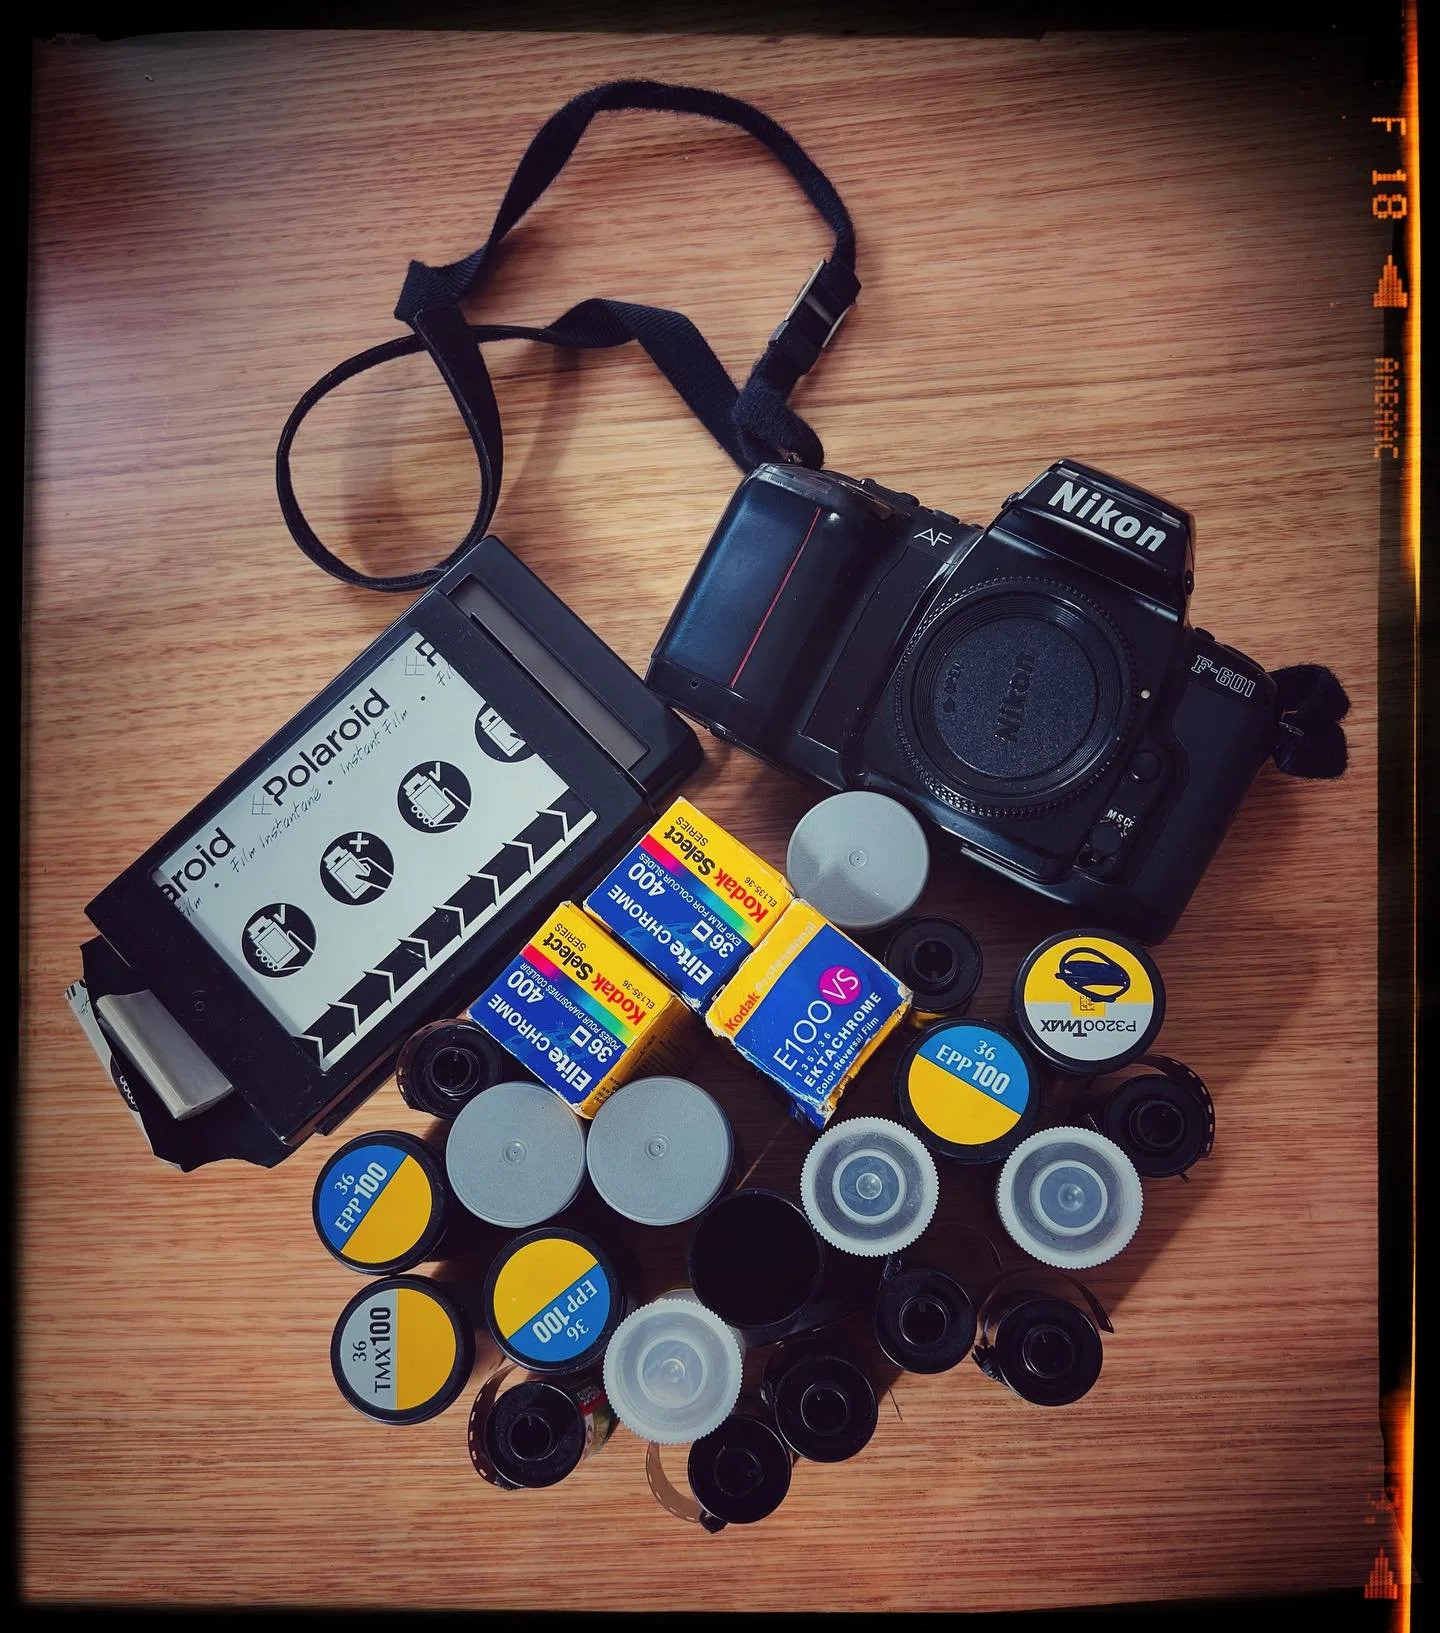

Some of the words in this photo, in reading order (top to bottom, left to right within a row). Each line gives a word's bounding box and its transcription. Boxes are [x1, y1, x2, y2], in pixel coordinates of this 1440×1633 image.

[1048, 480, 1167, 553] Nikon
[913, 527, 953, 547] AF
[1190, 654, 1256, 698] F-601
[262, 687, 391, 808] Polaroid
[230, 848, 257, 874] Film
[340, 733, 382, 777] Instant
[382, 707, 410, 736] Film
[675, 816, 709, 847] SERIES
[639, 853, 665, 878] SLIDES
[663, 825, 715, 876] Select
[628, 862, 665, 898] 400
[663, 874, 695, 904] COLOUR
[713, 868, 769, 923] Kodak
[607, 884, 672, 945] CHROME
[694, 899, 710, 917] FOR
[707, 912, 726, 932] FILM
[554, 923, 587, 952] SERIES
[709, 935, 734, 959] 36
[725, 930, 741, 946] EXP
[542, 932, 594, 981] Select
[669, 943, 714, 986] Elite
[507, 970, 544, 1004] 400
[519, 962, 548, 988] COULEUR
[546, 983, 586, 1023] DIAPOSITIVES
[591, 972, 647, 1026] Kodak
[724, 991, 760, 1032] Kodak
[487, 994, 550, 1051] CHROME
[581, 1013, 602, 1034] POUR
[773, 1000, 832, 1071] E100
[822, 968, 859, 1000] VS
[587, 1040, 613, 1063] 36
[598, 1029, 621, 1051] POSES
[803, 991, 882, 1088] EKTACHROME
[816, 1069, 837, 1095] Color
[833, 1033, 862, 1069] Reversal
[861, 1016, 879, 1034] Film
[973, 1039, 997, 1062] 36
[548, 1047, 592, 1092] Elite
[334, 1171, 356, 1196] 36
[566, 1317, 589, 1341] 36
[352, 1339, 367, 1363] 36
